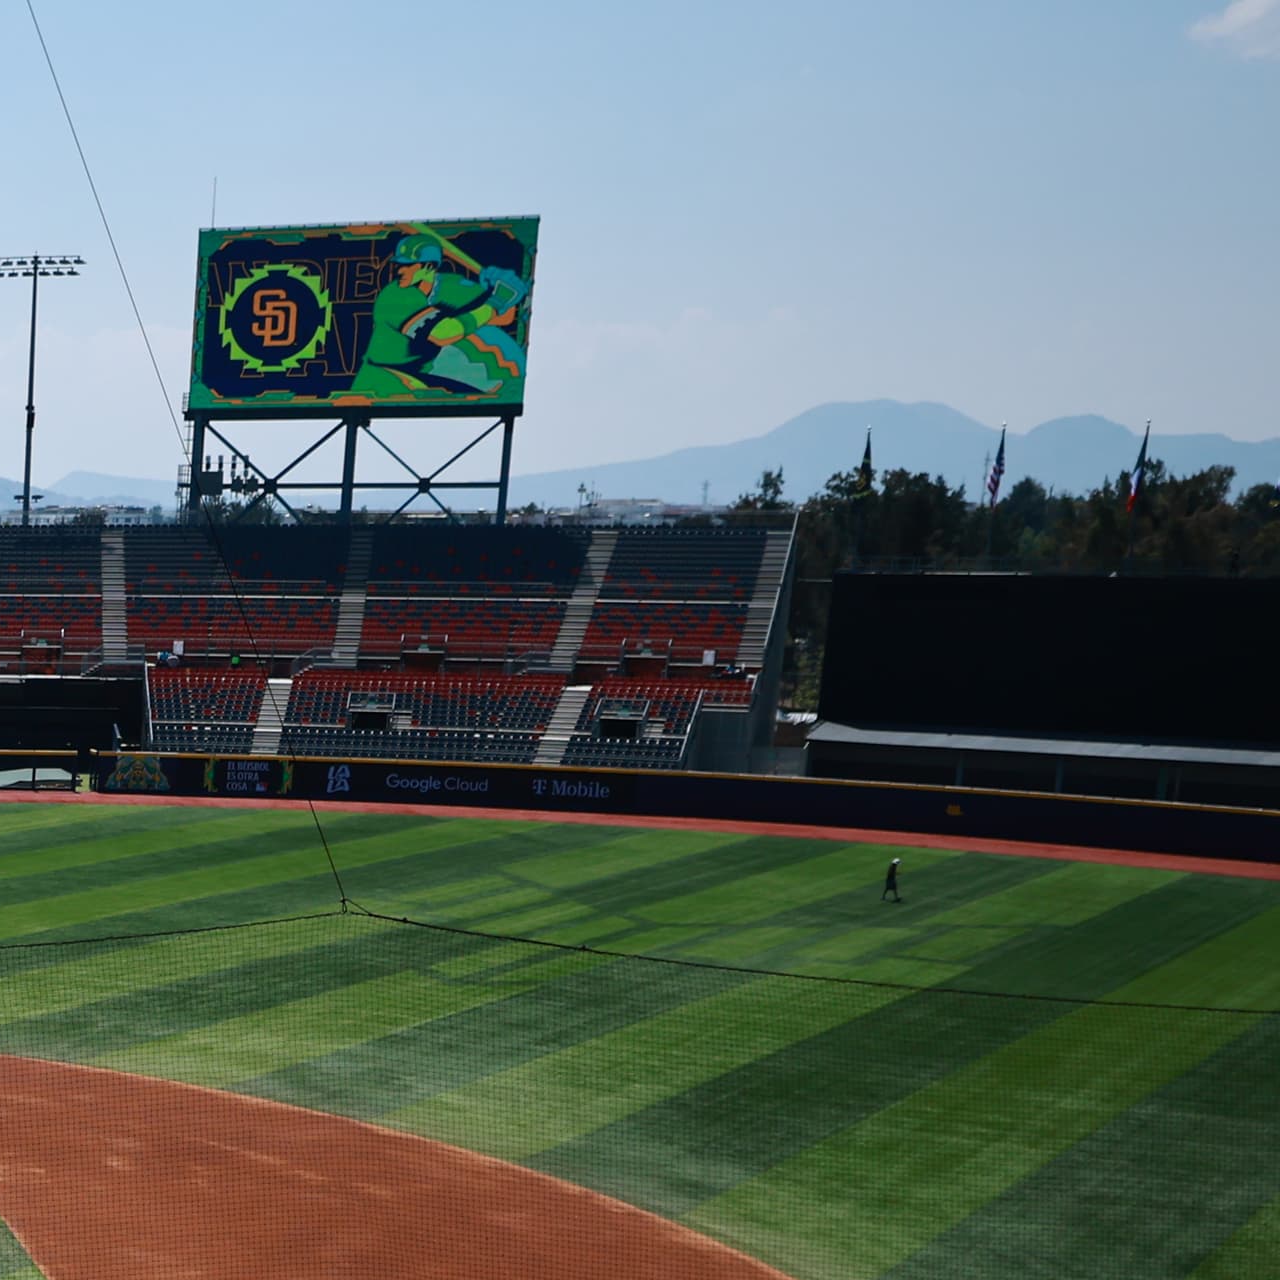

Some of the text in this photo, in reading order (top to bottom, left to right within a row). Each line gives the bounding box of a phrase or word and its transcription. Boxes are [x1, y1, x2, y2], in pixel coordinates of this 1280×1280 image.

[252, 290, 297, 347] SD
[226, 771, 259, 782] ES OTRA
[385, 773, 488, 793] Google Cloud
[225, 782, 248, 792] COSA
[551, 779, 611, 799] Mobile
